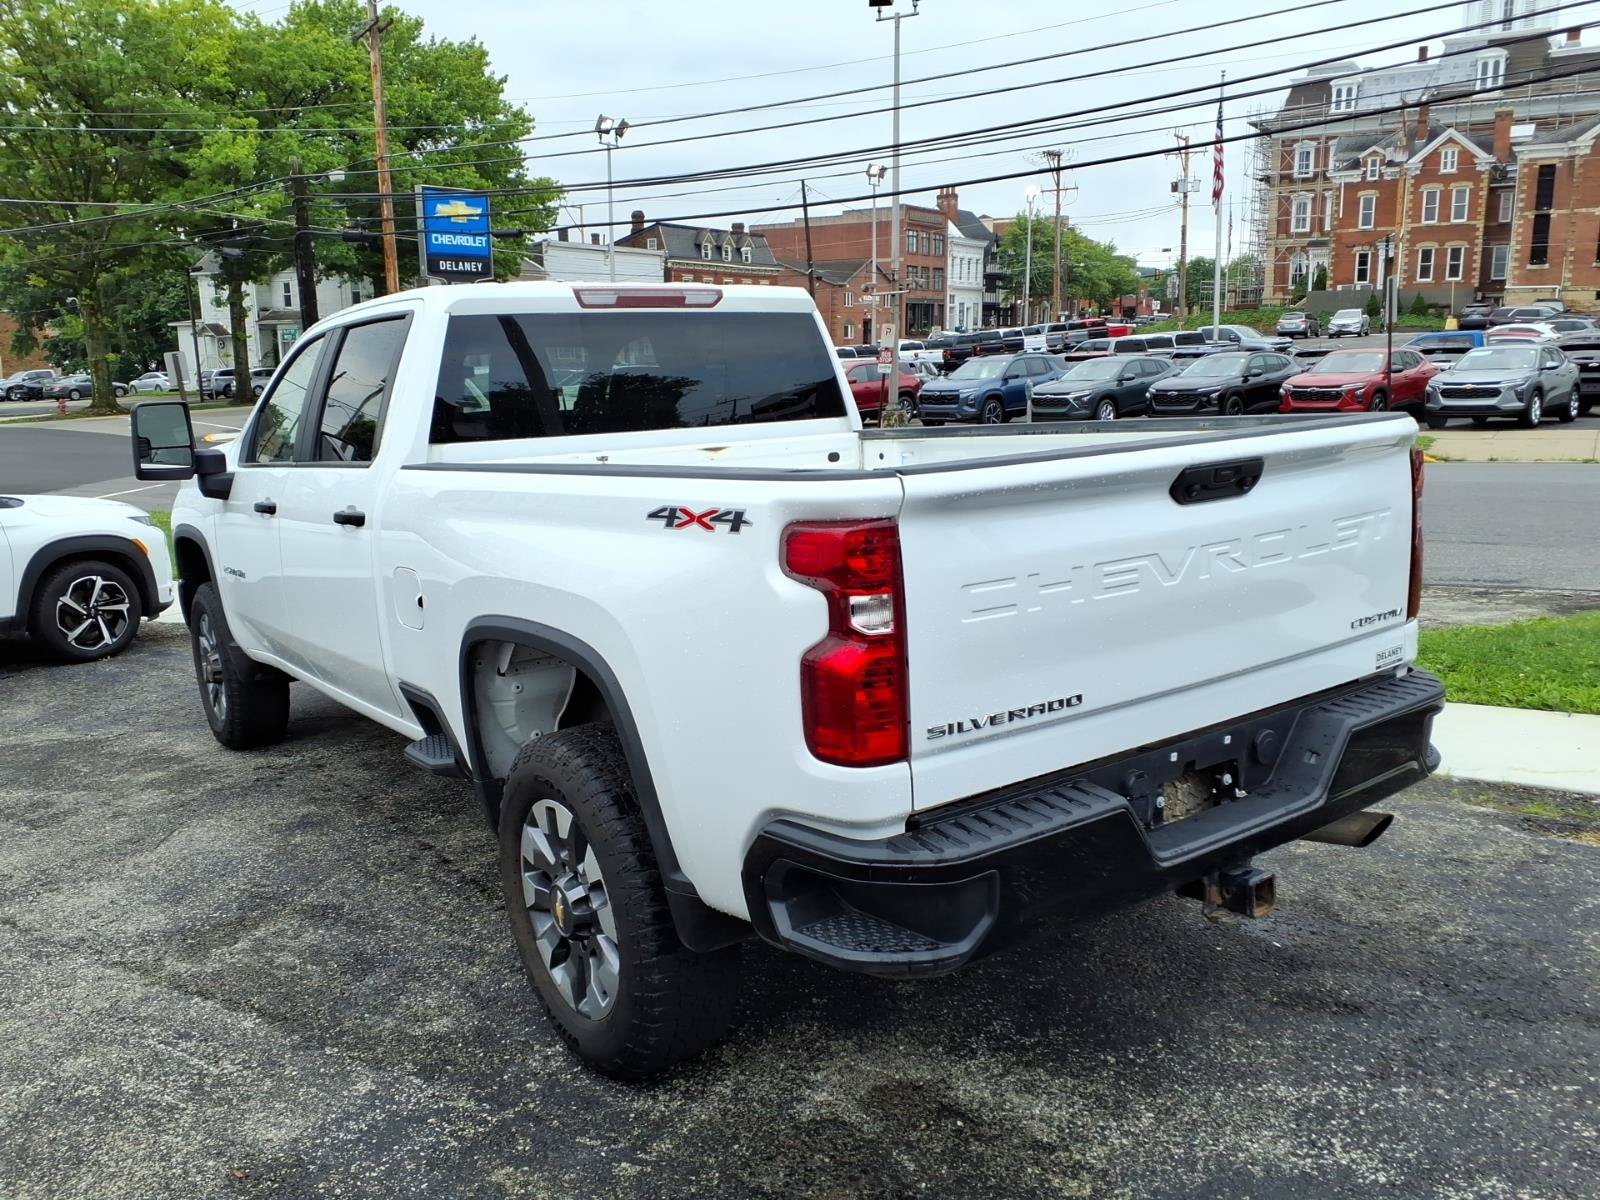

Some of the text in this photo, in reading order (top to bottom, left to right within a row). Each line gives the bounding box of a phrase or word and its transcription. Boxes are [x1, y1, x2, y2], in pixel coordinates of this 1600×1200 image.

[431, 233, 487, 247] CHEVROLET
[439, 260, 483, 272] DELANEY
[961, 507, 1392, 623] CHEVROLET
[1376, 646, 1403, 662] DELANEY
[926, 693, 1084, 740] SILVERADO
